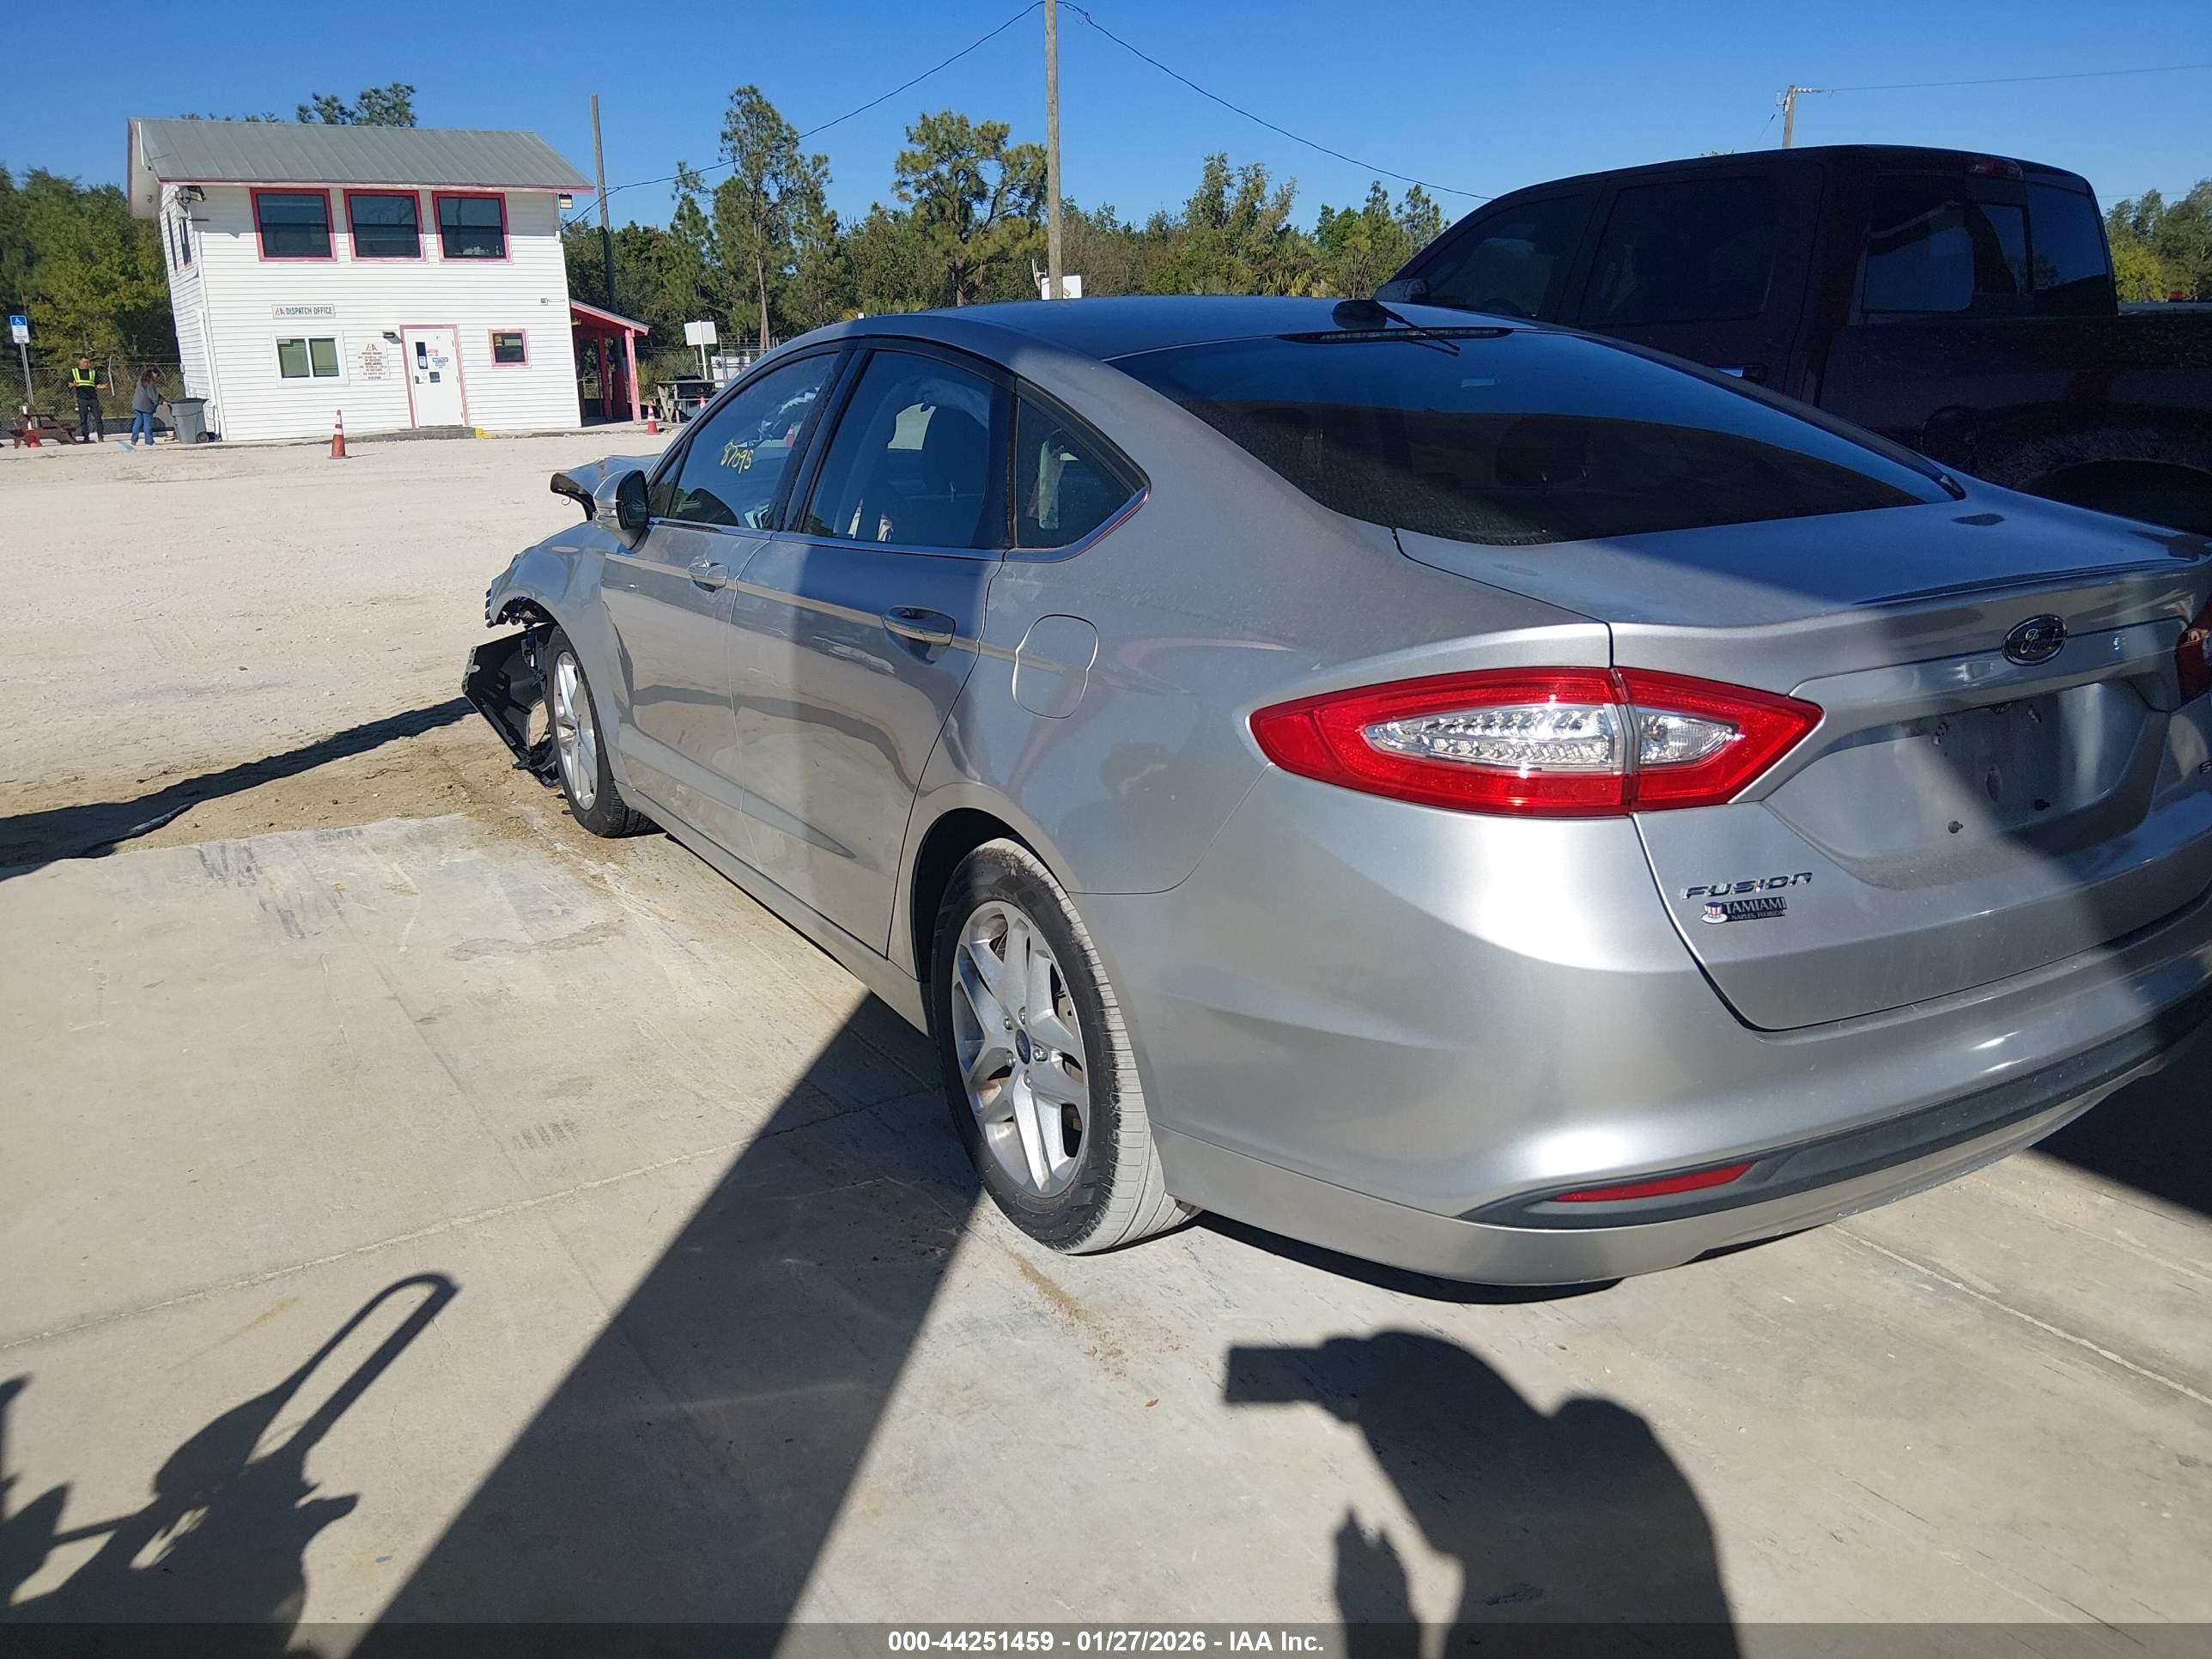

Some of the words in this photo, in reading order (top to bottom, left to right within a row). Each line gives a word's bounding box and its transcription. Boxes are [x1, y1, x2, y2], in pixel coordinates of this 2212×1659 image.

[720, 440, 754, 474] 87095
[1679, 872, 1814, 900] FUSION
[1723, 897, 1786, 915] TAMIAMI
